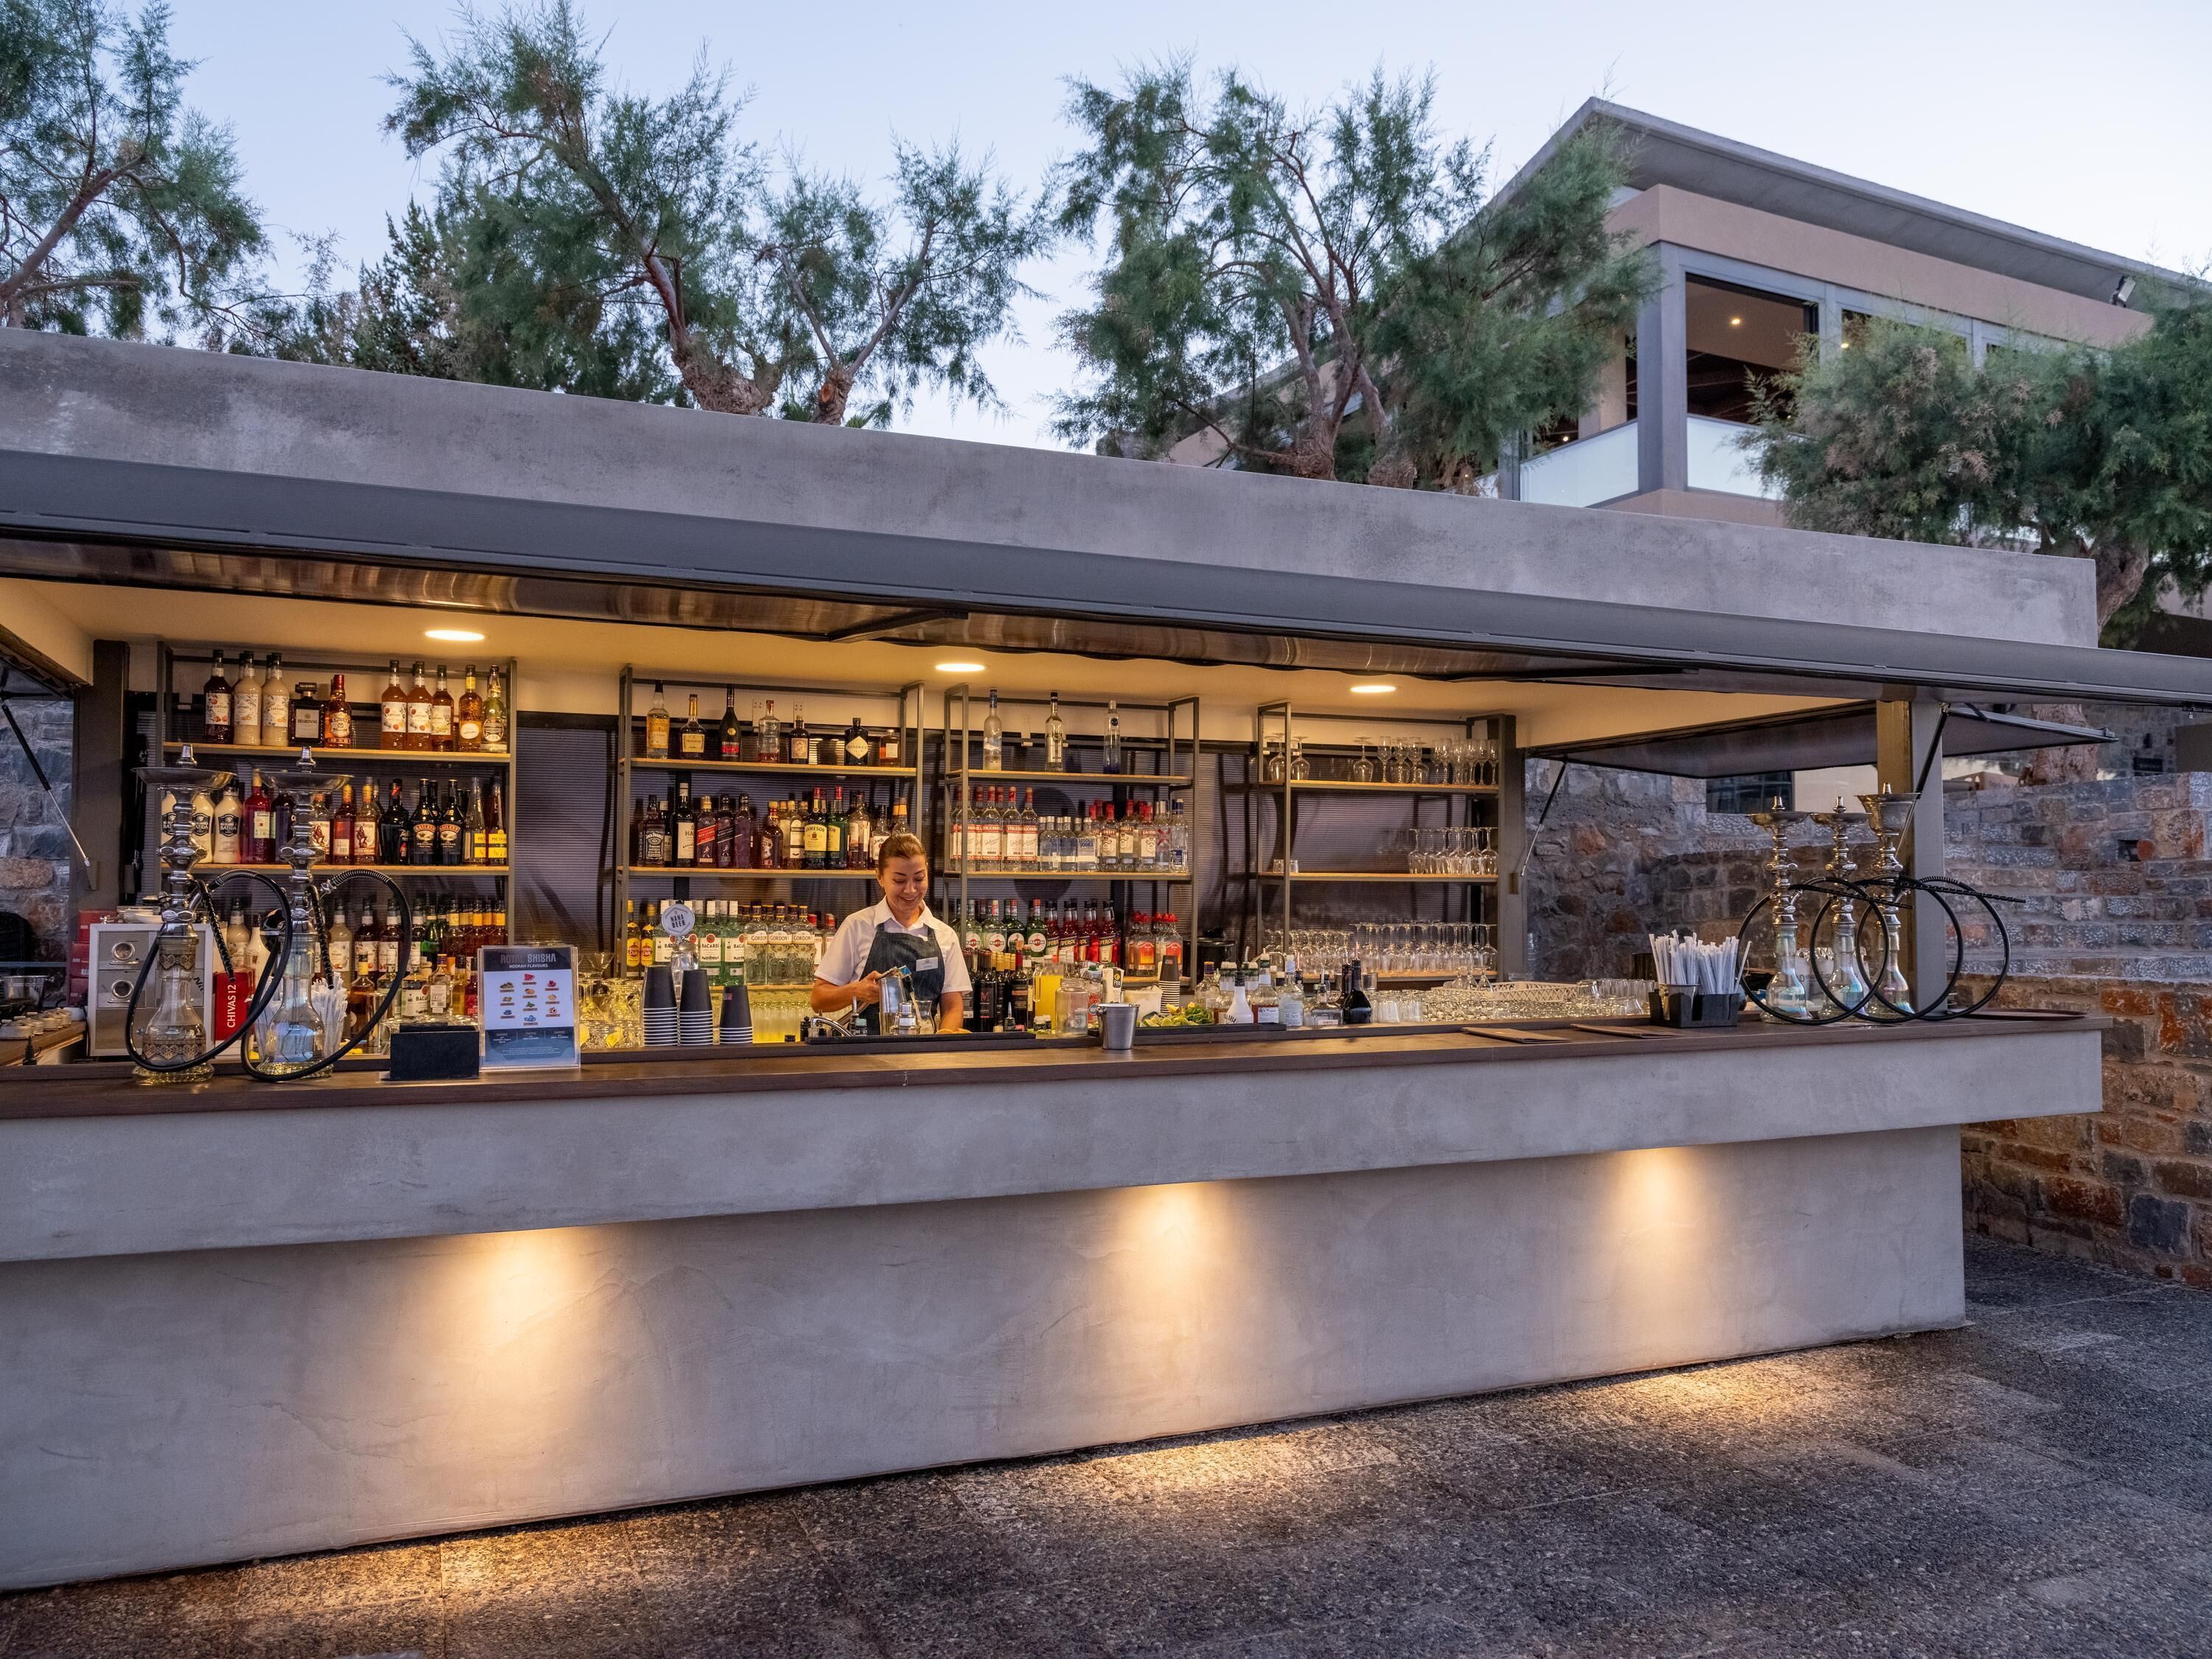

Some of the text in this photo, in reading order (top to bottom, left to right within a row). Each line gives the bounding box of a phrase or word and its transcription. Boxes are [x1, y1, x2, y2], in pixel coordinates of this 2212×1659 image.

[669, 914, 684, 922] NANA
[672, 919, 686, 928] BEER
[501, 953, 557, 964] ROYAL SHISHA
[227, 984, 237, 1028] CHIVAS 12
